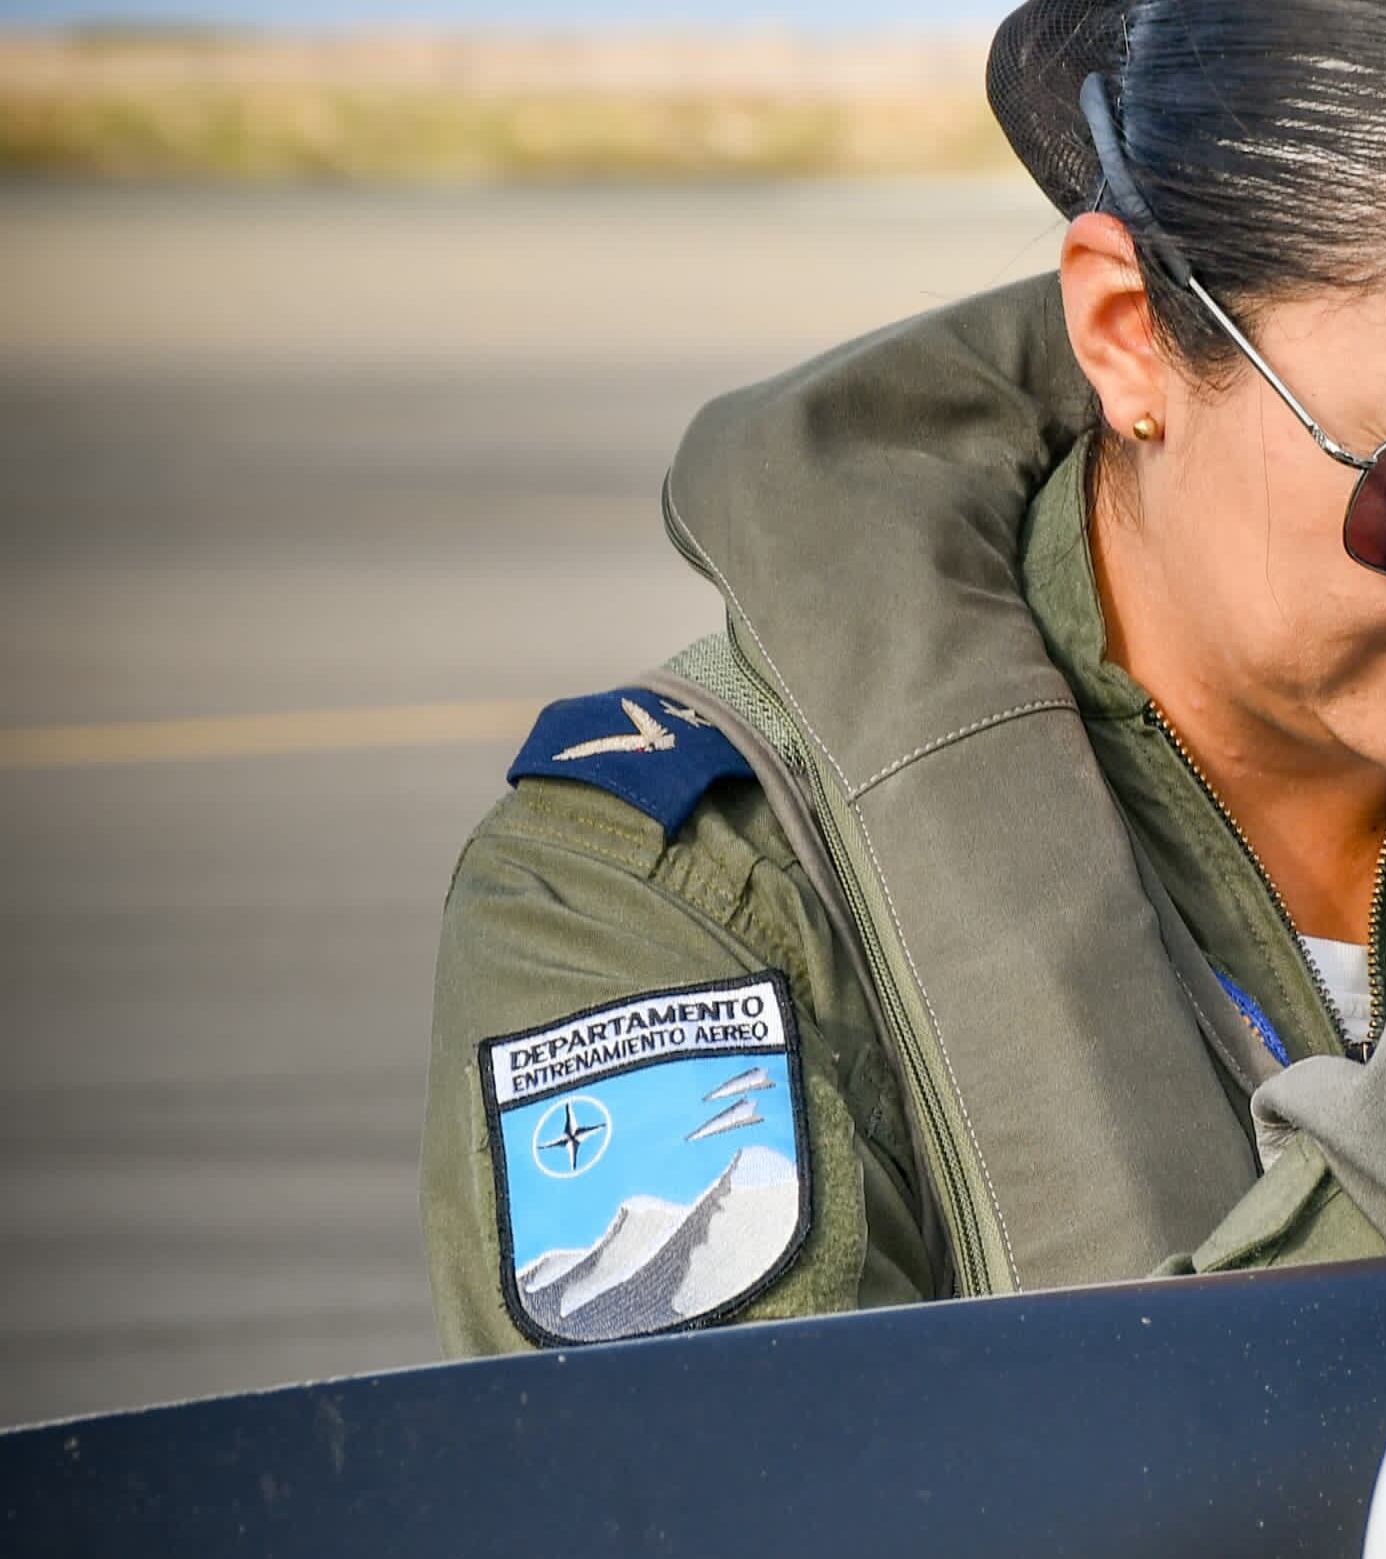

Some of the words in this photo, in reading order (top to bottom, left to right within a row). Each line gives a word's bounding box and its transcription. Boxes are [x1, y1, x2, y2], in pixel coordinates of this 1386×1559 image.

[510, 996, 764, 1070] DEPARTAMENTO
[512, 1027, 685, 1092] ENTRENAMIENTO
[694, 1020, 769, 1044] AEREO
